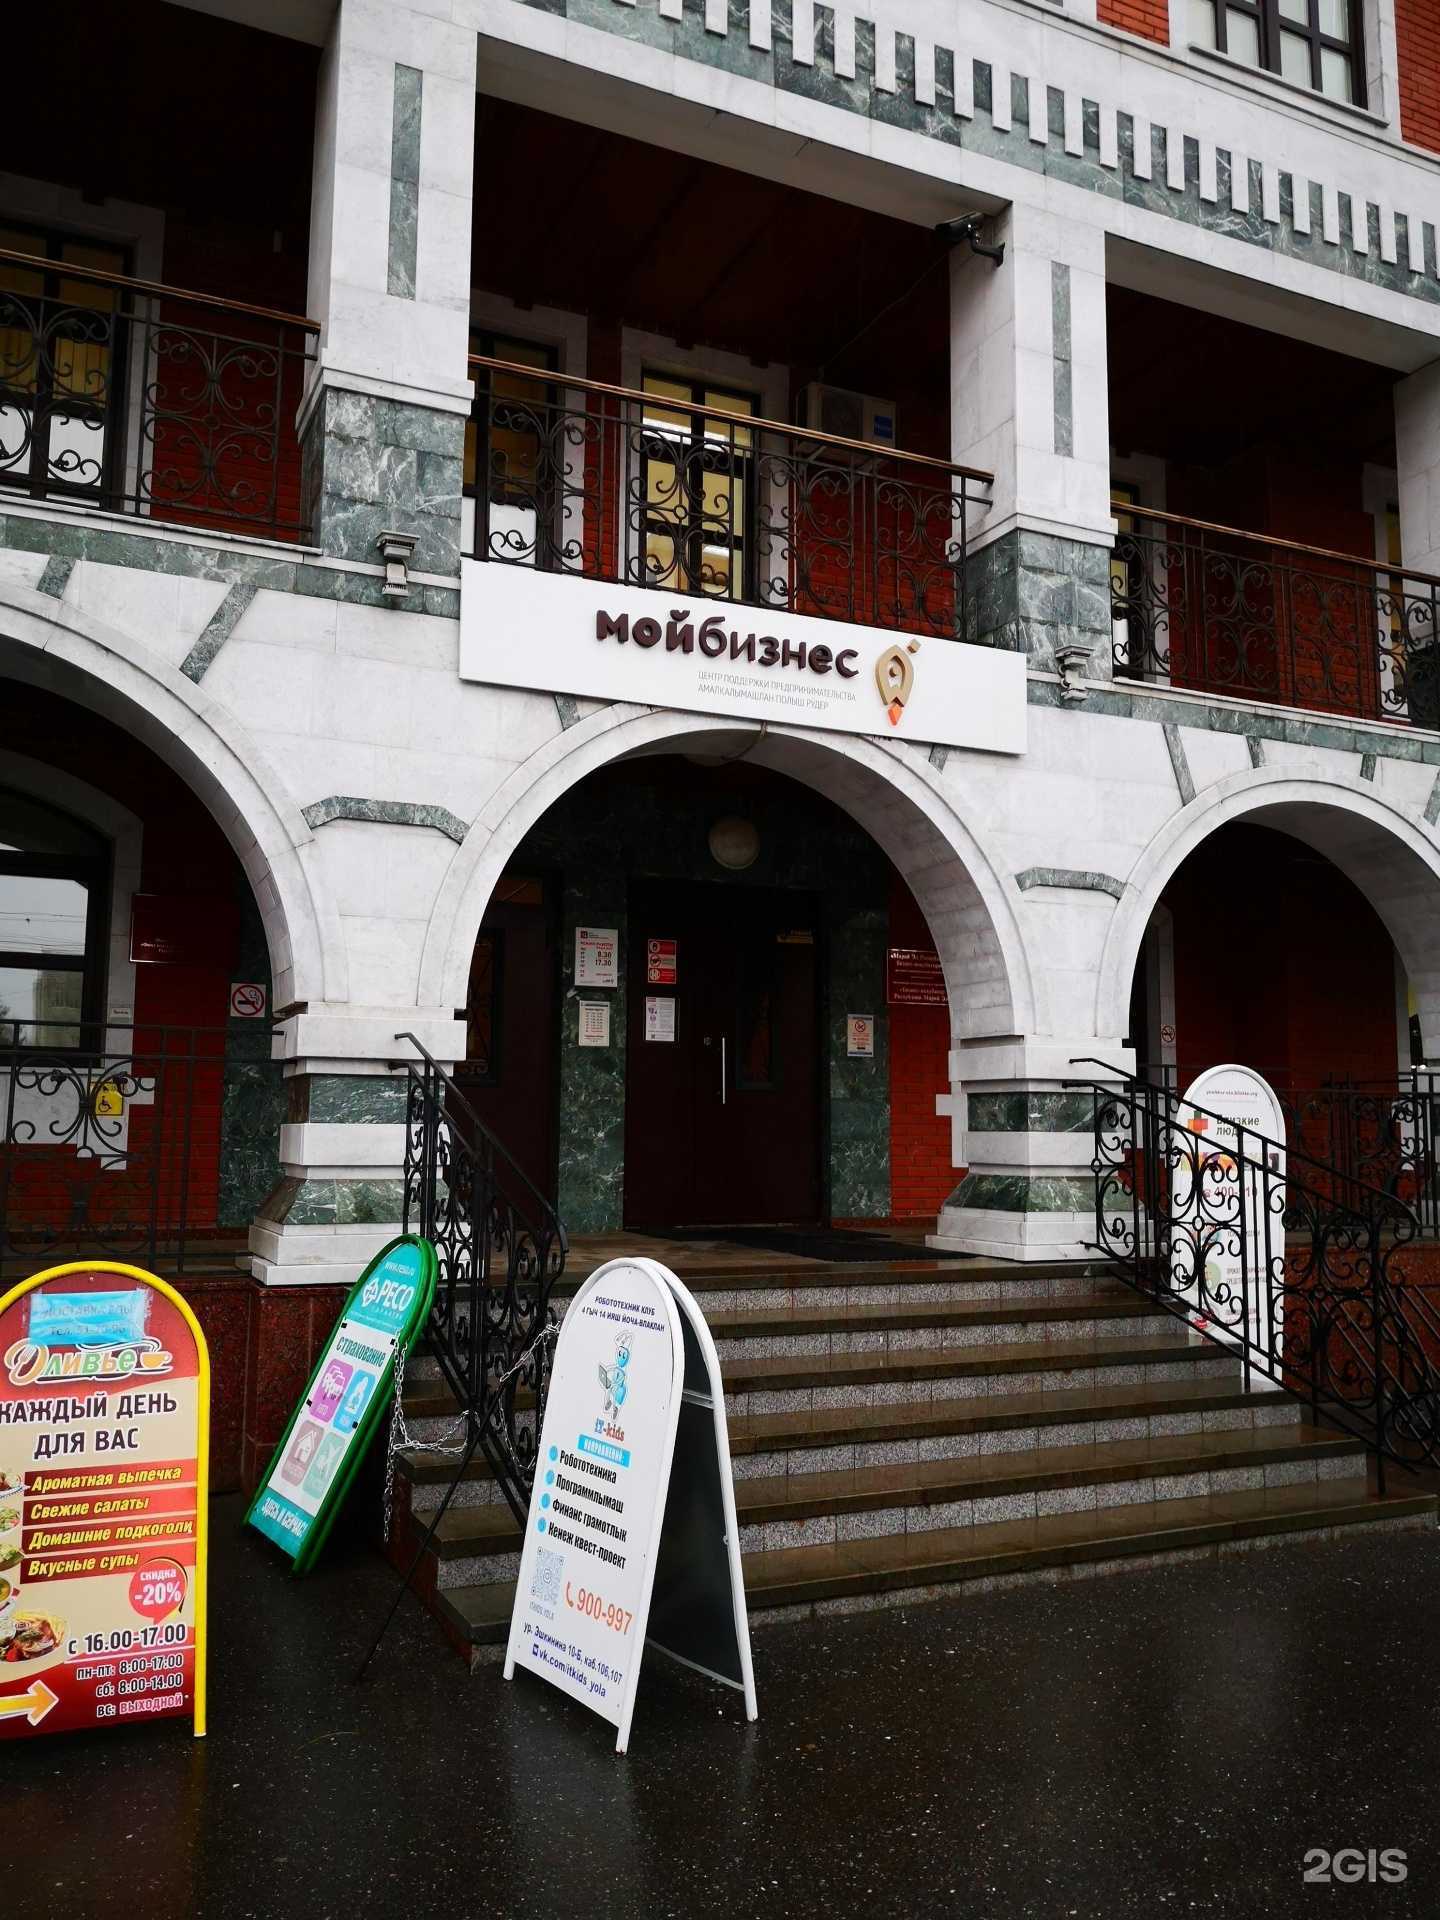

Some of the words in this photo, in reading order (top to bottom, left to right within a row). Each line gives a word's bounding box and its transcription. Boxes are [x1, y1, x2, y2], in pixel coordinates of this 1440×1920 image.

[596, 609, 860, 680] мойбизнес
[698, 671, 723, 682] ЦЕНТР
[724, 675, 770, 691] ПОДДЕРЖКИ
[771, 682, 857, 703] ПРЕДПРИНИМАТЕЛЬСТВА
[595, 1296, 641, 1314] РОБОТОТЕХНИК
[642, 1305, 655, 1316] КЛУБ
[116, 1393, 177, 1419] ДЕНЬ
[33, 1432, 85, 1459] ДЛЯ
[95, 1428, 139, 1451] ВАС
[31, 1474, 113, 1493] Ароматная
[118, 1467, 182, 1485] выпечка
[560, 1450, 617, 1484] Робототехника
[31, 1501, 89, 1520] Свежие
[93, 1497, 149, 1514] салаты
[556, 1474, 624, 1514] Программлымаш
[29, 1529, 111, 1550] Домашние
[115, 1520, 193, 1541] подкоголи
[552, 1497, 583, 1524] Финанс
[583, 1512, 627, 1543] грамотлык
[28, 1556, 95, 1577] Вкусные
[100, 1553, 139, 1571] супы
[574, 1535, 626, 1570] квест-проект
[134, 1582, 181, 1606] -20%
[576, 1587, 633, 1635] 900-997
[84, 1623, 187, 1653] 16.00-17.00
[523, 1622, 533, 1636] ур.
[535, 1626, 567, 1652] Эшкинина
[119, 1654, 183, 1675] 8:00-17:00
[118, 1674, 183, 1695] 8:00-14.00
